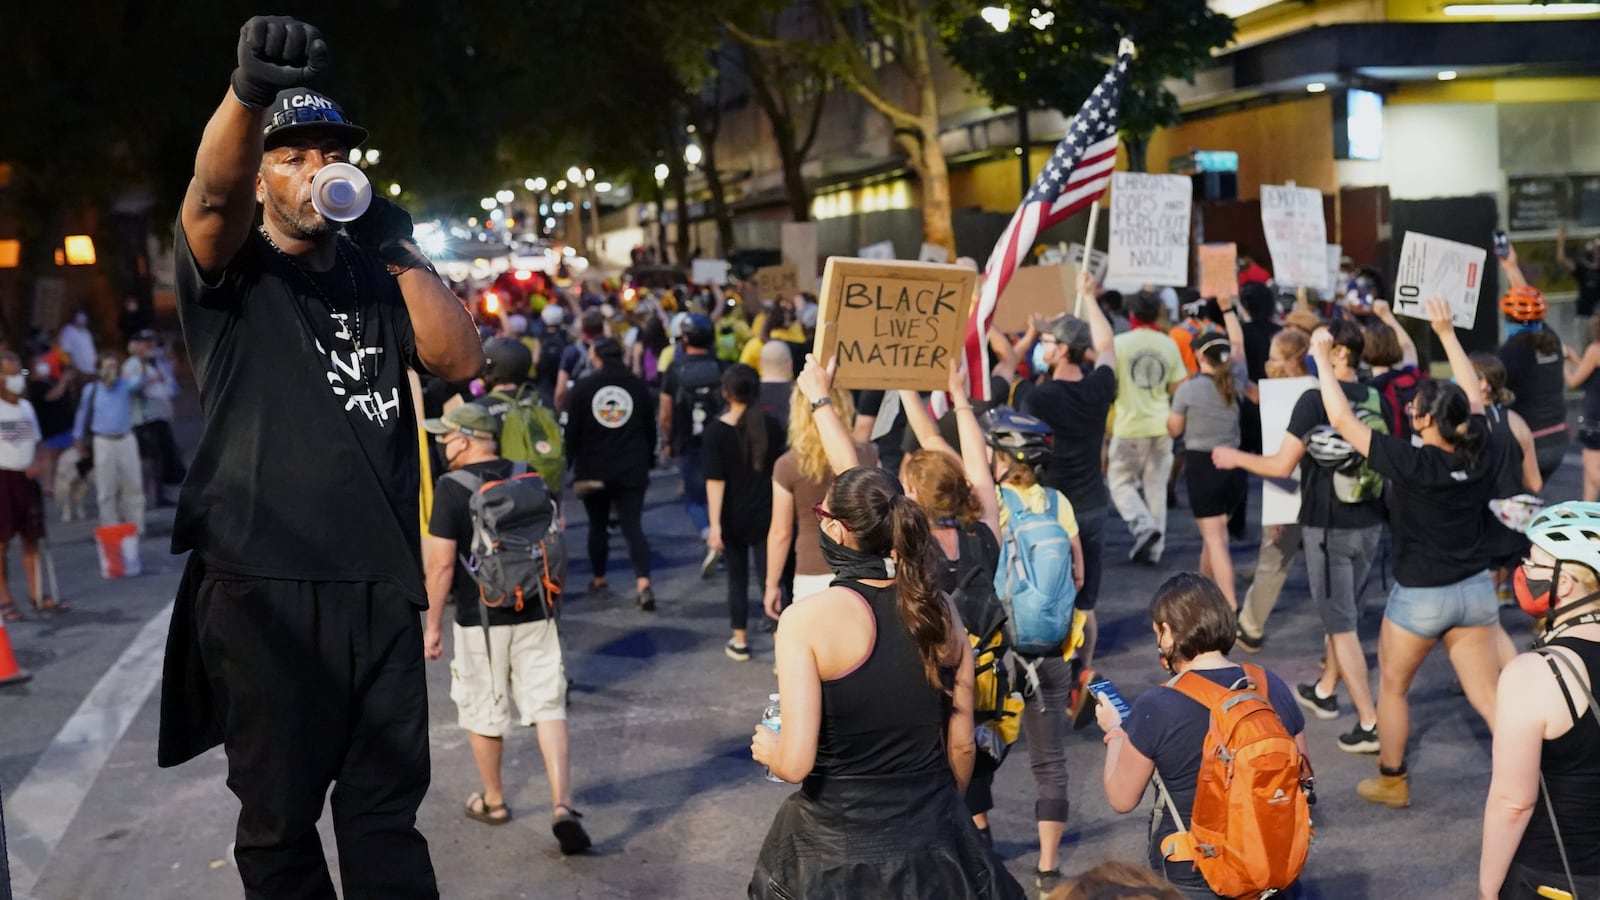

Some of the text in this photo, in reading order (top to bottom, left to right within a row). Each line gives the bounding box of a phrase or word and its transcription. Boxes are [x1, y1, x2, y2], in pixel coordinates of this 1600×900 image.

[283, 98, 289, 110] I
[1115, 192, 1157, 213] COPS
[845, 283, 956, 315] BLACK
[1399, 285, 1420, 310] 10
[874, 316, 939, 343] LIVES
[836, 340, 948, 370] MATTER
